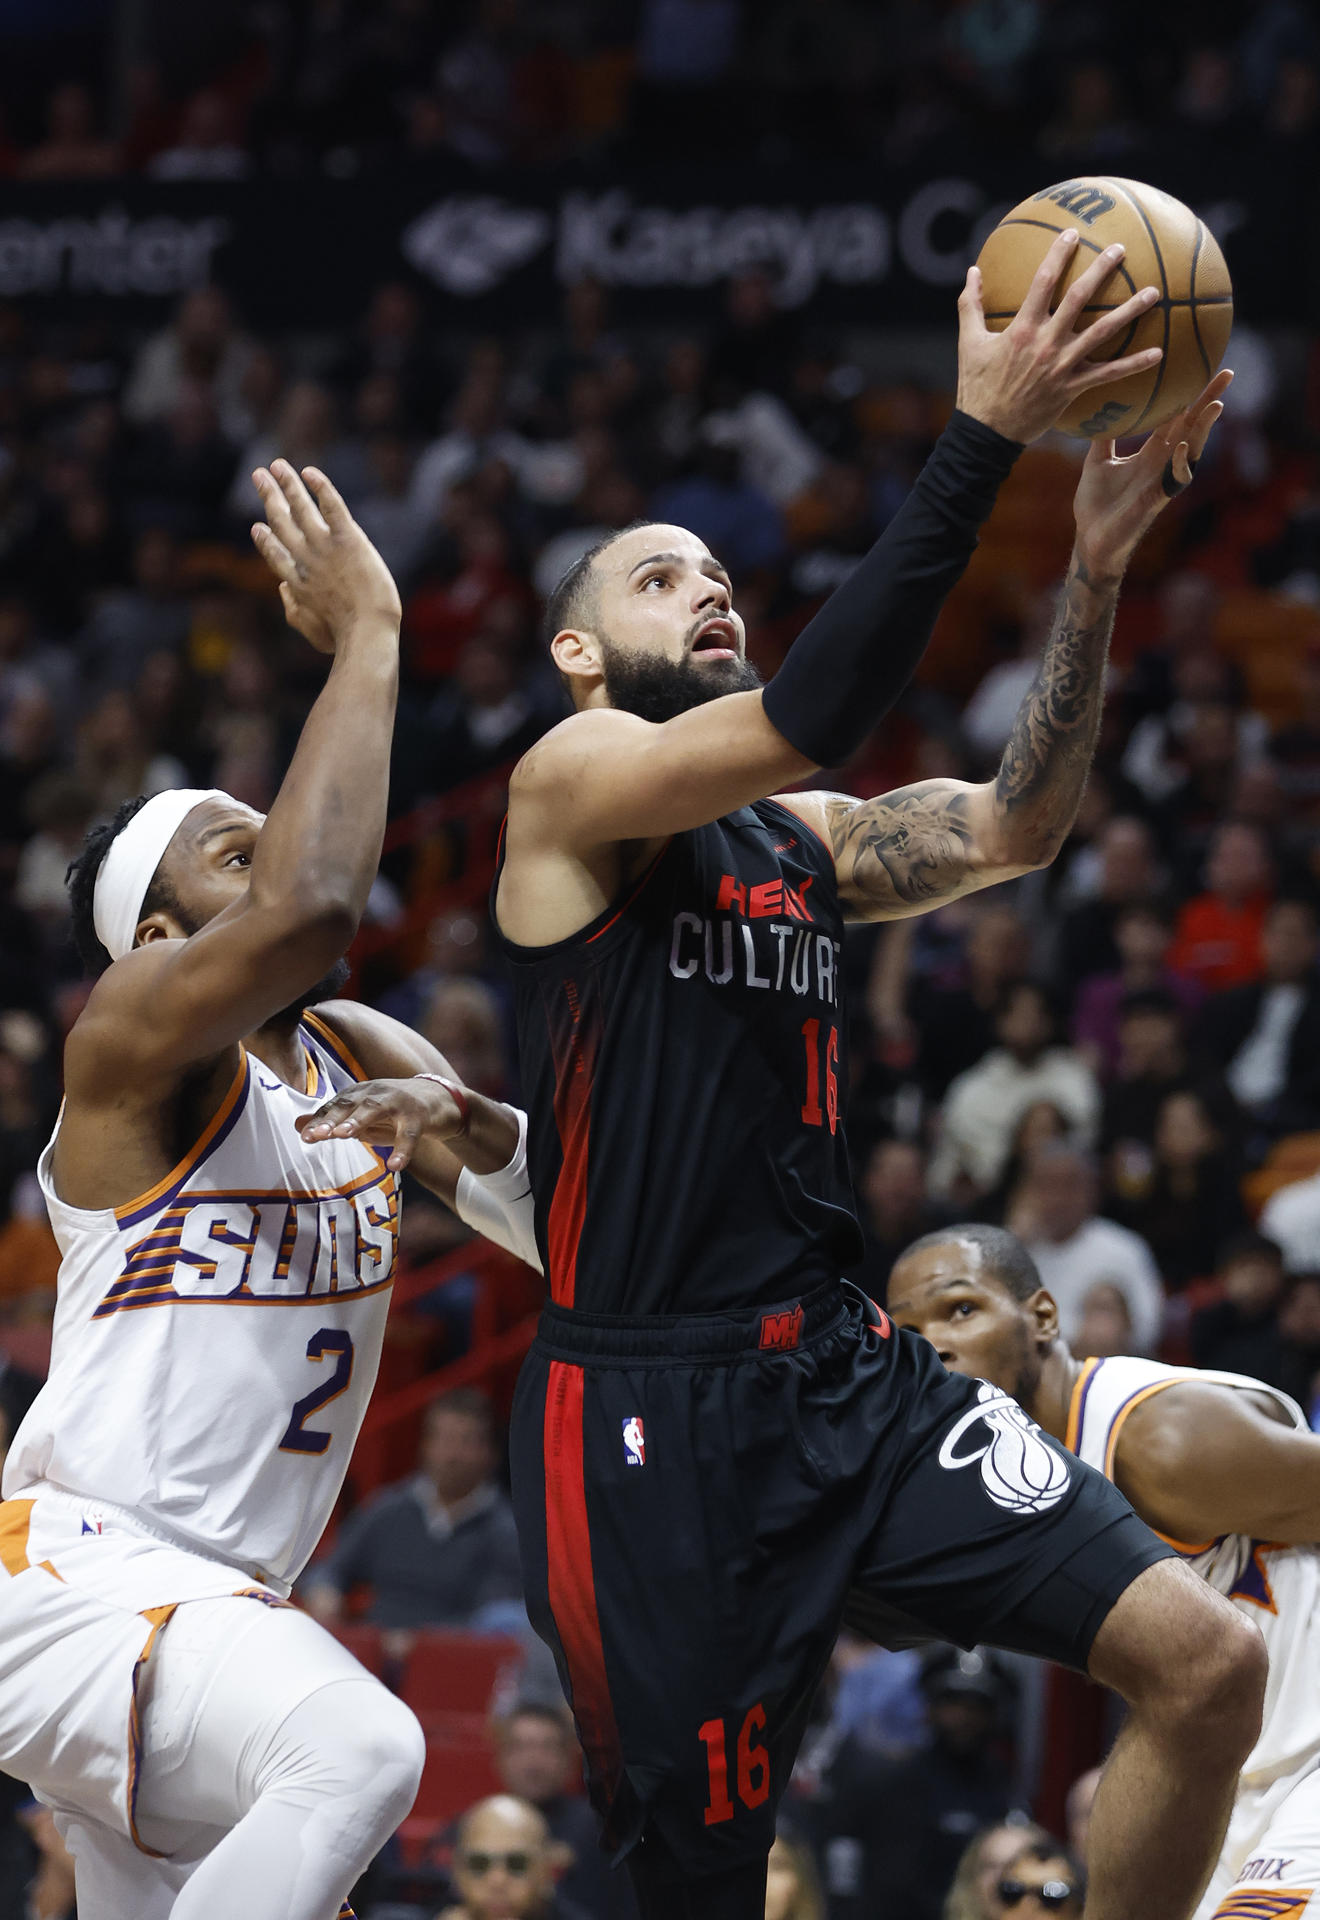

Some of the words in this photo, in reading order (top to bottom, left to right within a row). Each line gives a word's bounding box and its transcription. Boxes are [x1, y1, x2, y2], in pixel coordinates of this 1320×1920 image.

[556, 188, 890, 307] Kaseya
[801, 1017, 841, 1137] 16
[170, 1186, 394, 1297] SUNS
[278, 1327, 354, 1456] 2
[698, 1703, 771, 1826] 16
